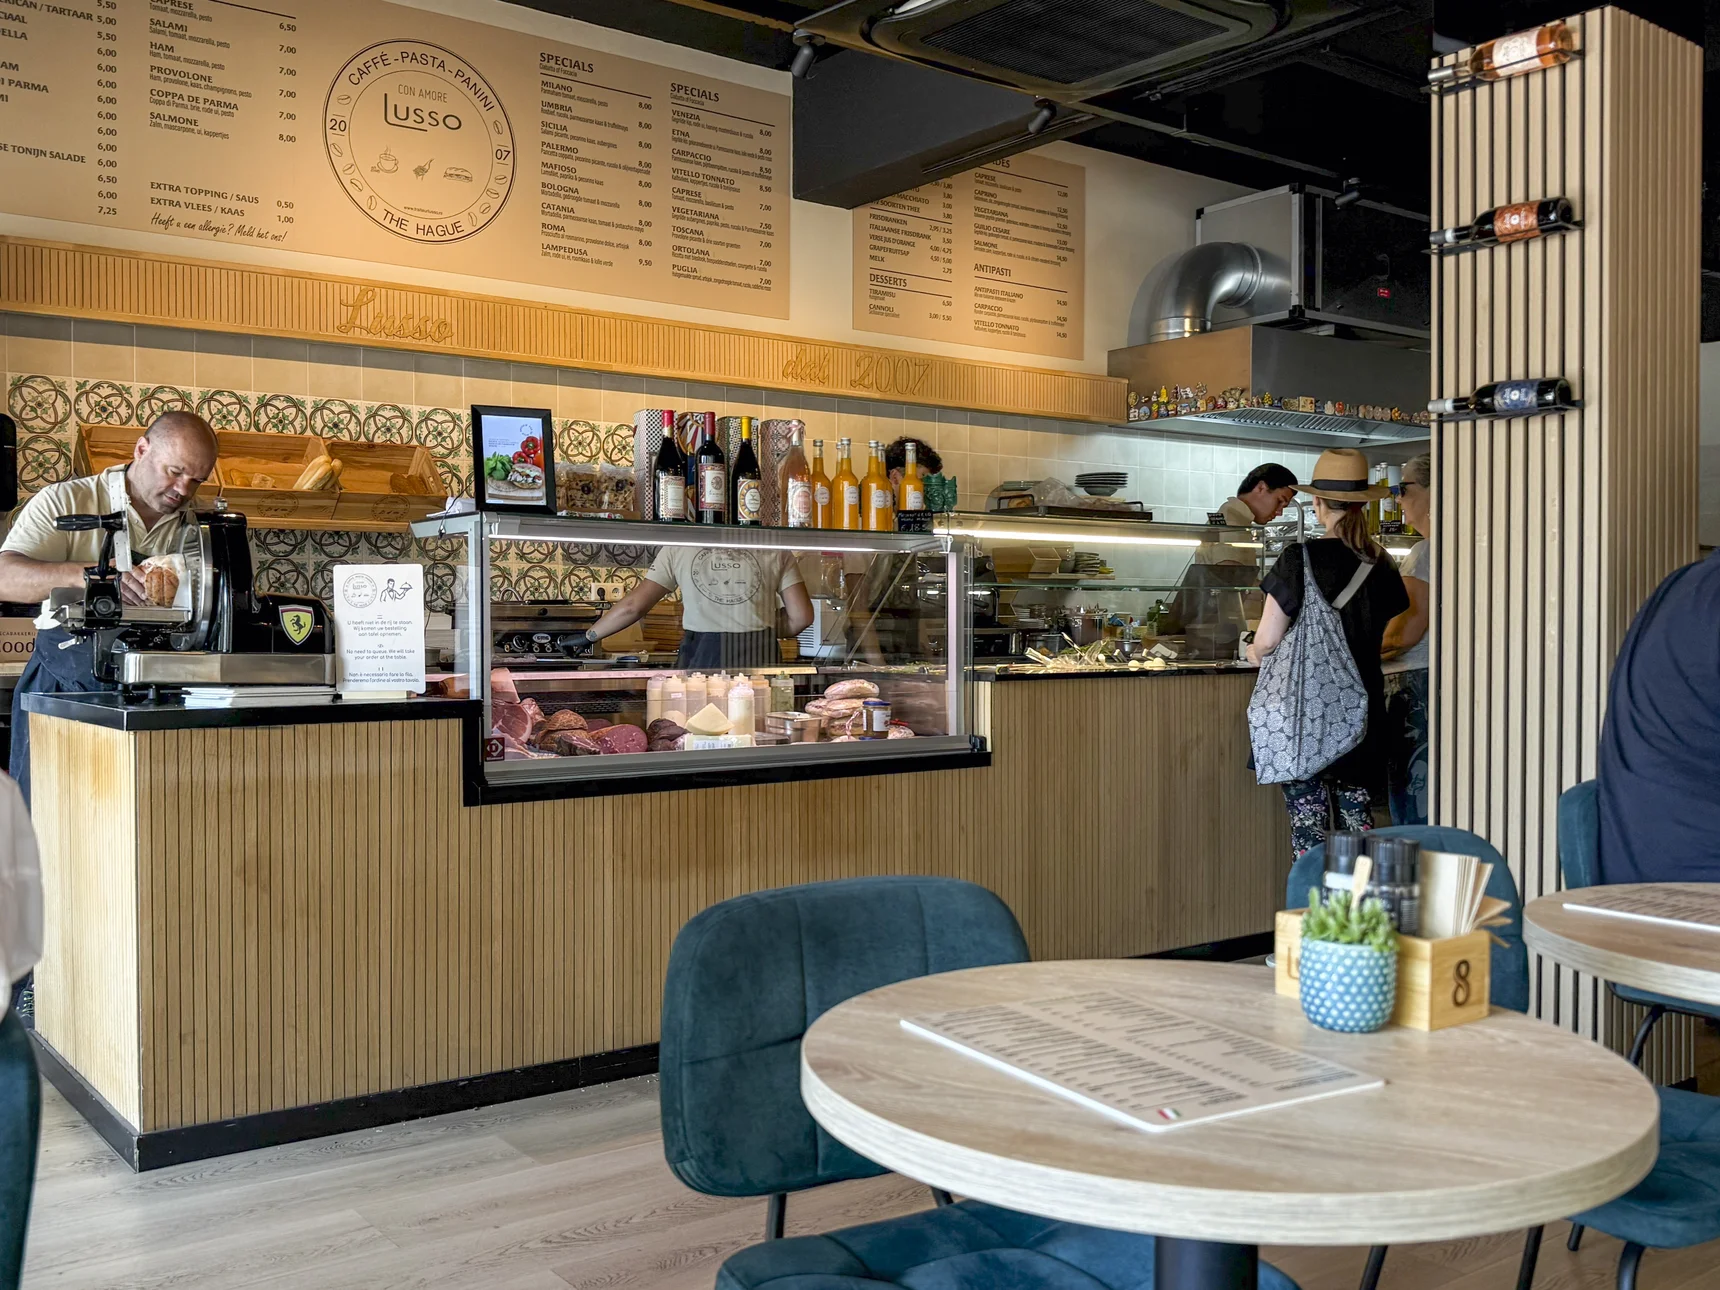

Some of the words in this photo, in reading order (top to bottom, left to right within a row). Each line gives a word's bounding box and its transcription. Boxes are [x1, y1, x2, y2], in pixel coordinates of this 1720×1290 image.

[97, 0, 117, 10] 5,50
[45, 4, 93, 21] TARTAAR
[97, 16, 117, 26] 5,00
[149, 18, 188, 32] SALAMI
[279, 22, 297, 32] 6,50
[0, 28, 28, 40] ELLA
[97, 32, 117, 41] 5,50
[150, 41, 175, 53] HAM
[216, 40, 231, 49] pesto
[278, 45, 297, 54] 7,00
[97, 48, 117, 57] 6,00
[539, 52, 594, 73] SPECIALS
[97, 64, 117, 73] 6,00
[278, 66, 297, 76] 7,00
[150, 65, 213, 84] PROVOLONE
[8, 78, 49, 93] PARMA
[97, 80, 117, 89] 6,00
[541, 80, 573, 93] MILANO
[278, 89, 297, 99] 7,00
[397, 83, 416, 97] CON
[417, 88, 448, 103] AMORE
[670, 82, 720, 103] SPECIALS
[97, 95, 117, 105] 6,00
[149, 88, 185, 101] COPPA
[187, 95, 200, 104] DE
[203, 97, 239, 111] PARMA
[541, 100, 573, 113] UMBRIA
[638, 101, 652, 111] 8,00
[98, 111, 117, 120] 6,00
[149, 111, 199, 127] SALMONE
[278, 111, 296, 121] 7,00
[671, 109, 700, 121] VENEZIA
[329, 118, 347, 132] 20
[541, 120, 568, 132] SICILIA
[638, 121, 652, 130] 8,00
[98, 127, 117, 136] 6,00
[671, 128, 690, 139] ETNA
[759, 128, 772, 137] 8,00
[278, 133, 296, 143] 8,00
[98, 143, 117, 152] 6,00
[541, 141, 579, 154] PALERMO
[638, 140, 652, 150] 8,00
[10, 145, 47, 158] TONIJN
[49, 151, 86, 163] SALADE
[495, 148, 511, 161] 07
[671, 148, 712, 161] CARPACCIO
[759, 147, 772, 156] 8,00
[98, 159, 117, 168] 6,00
[541, 161, 577, 174] MAFIOSO
[638, 160, 652, 169] 8,00
[759, 166, 772, 175] 8,50
[98, 175, 117, 184] 6,50
[671, 167, 700, 179] VITELLO
[702, 172, 735, 186] TONNATO
[541, 181, 579, 195] BOLOGNA
[638, 180, 652, 189] 8,00
[759, 184, 772, 193] 8,50
[98, 190, 117, 200] 6,00
[150, 181, 181, 193] EXTRA
[183, 186, 228, 200] TOPPING
[235, 194, 260, 204] SAUS
[671, 186, 702, 198] CAPRESE
[150, 196, 181, 208] EXTRA
[183, 201, 213, 212] VLEES
[220, 206, 245, 217] KAAS
[276, 200, 294, 209] 0,50
[541, 202, 576, 214] CATANIA
[638, 199, 652, 208] 8,00
[759, 203, 772, 212] 7,00
[98, 206, 117, 215] 7,25
[671, 206, 720, 220] VEGETARIANA
[276, 215, 294, 224] 1,00
[382, 208, 410, 232] THE
[415, 220, 465, 238] HAGUE
[638, 219, 652, 228] 8,00
[150, 212, 174, 230] Heeft
[183, 221, 196, 230] een
[199, 219, 235, 237] allergie?
[234, 224, 256, 238] Meld
[256, 228, 269, 240] het
[271, 231, 288, 242] ons!
[541, 222, 566, 232] ROMA
[671, 225, 704, 237] TOSCANA
[759, 222, 772, 230] 7,50
[638, 238, 652, 247] 8,00
[759, 240, 772, 249] 7,00
[541, 243, 588, 257] LAMPEDUSA
[671, 244, 710, 257] ORTOLANA
[638, 258, 652, 267] 9,50
[759, 259, 772, 267] 7,00
[869, 254, 885, 263] MELK
[671, 263, 698, 274] PUGLIA
[974, 263, 1011, 277] ANTIPASTI
[759, 277, 772, 286] 7,00
[869, 273, 907, 288] DESSERTS
[869, 288, 896, 298] TIRAMISU
[974, 286, 1000, 295] ANTIPASTI
[1001, 290, 1023, 299] ITALIANO
[869, 303, 894, 313] CANNOLI
[974, 303, 1003, 312] CARPACCIO
[337, 287, 455, 343] Lusso
[974, 319, 994, 328] VITELLO
[995, 322, 1019, 331] TONNATO
[851, 355, 929, 395] 2007
[1453, 959, 1471, 1006] 8
